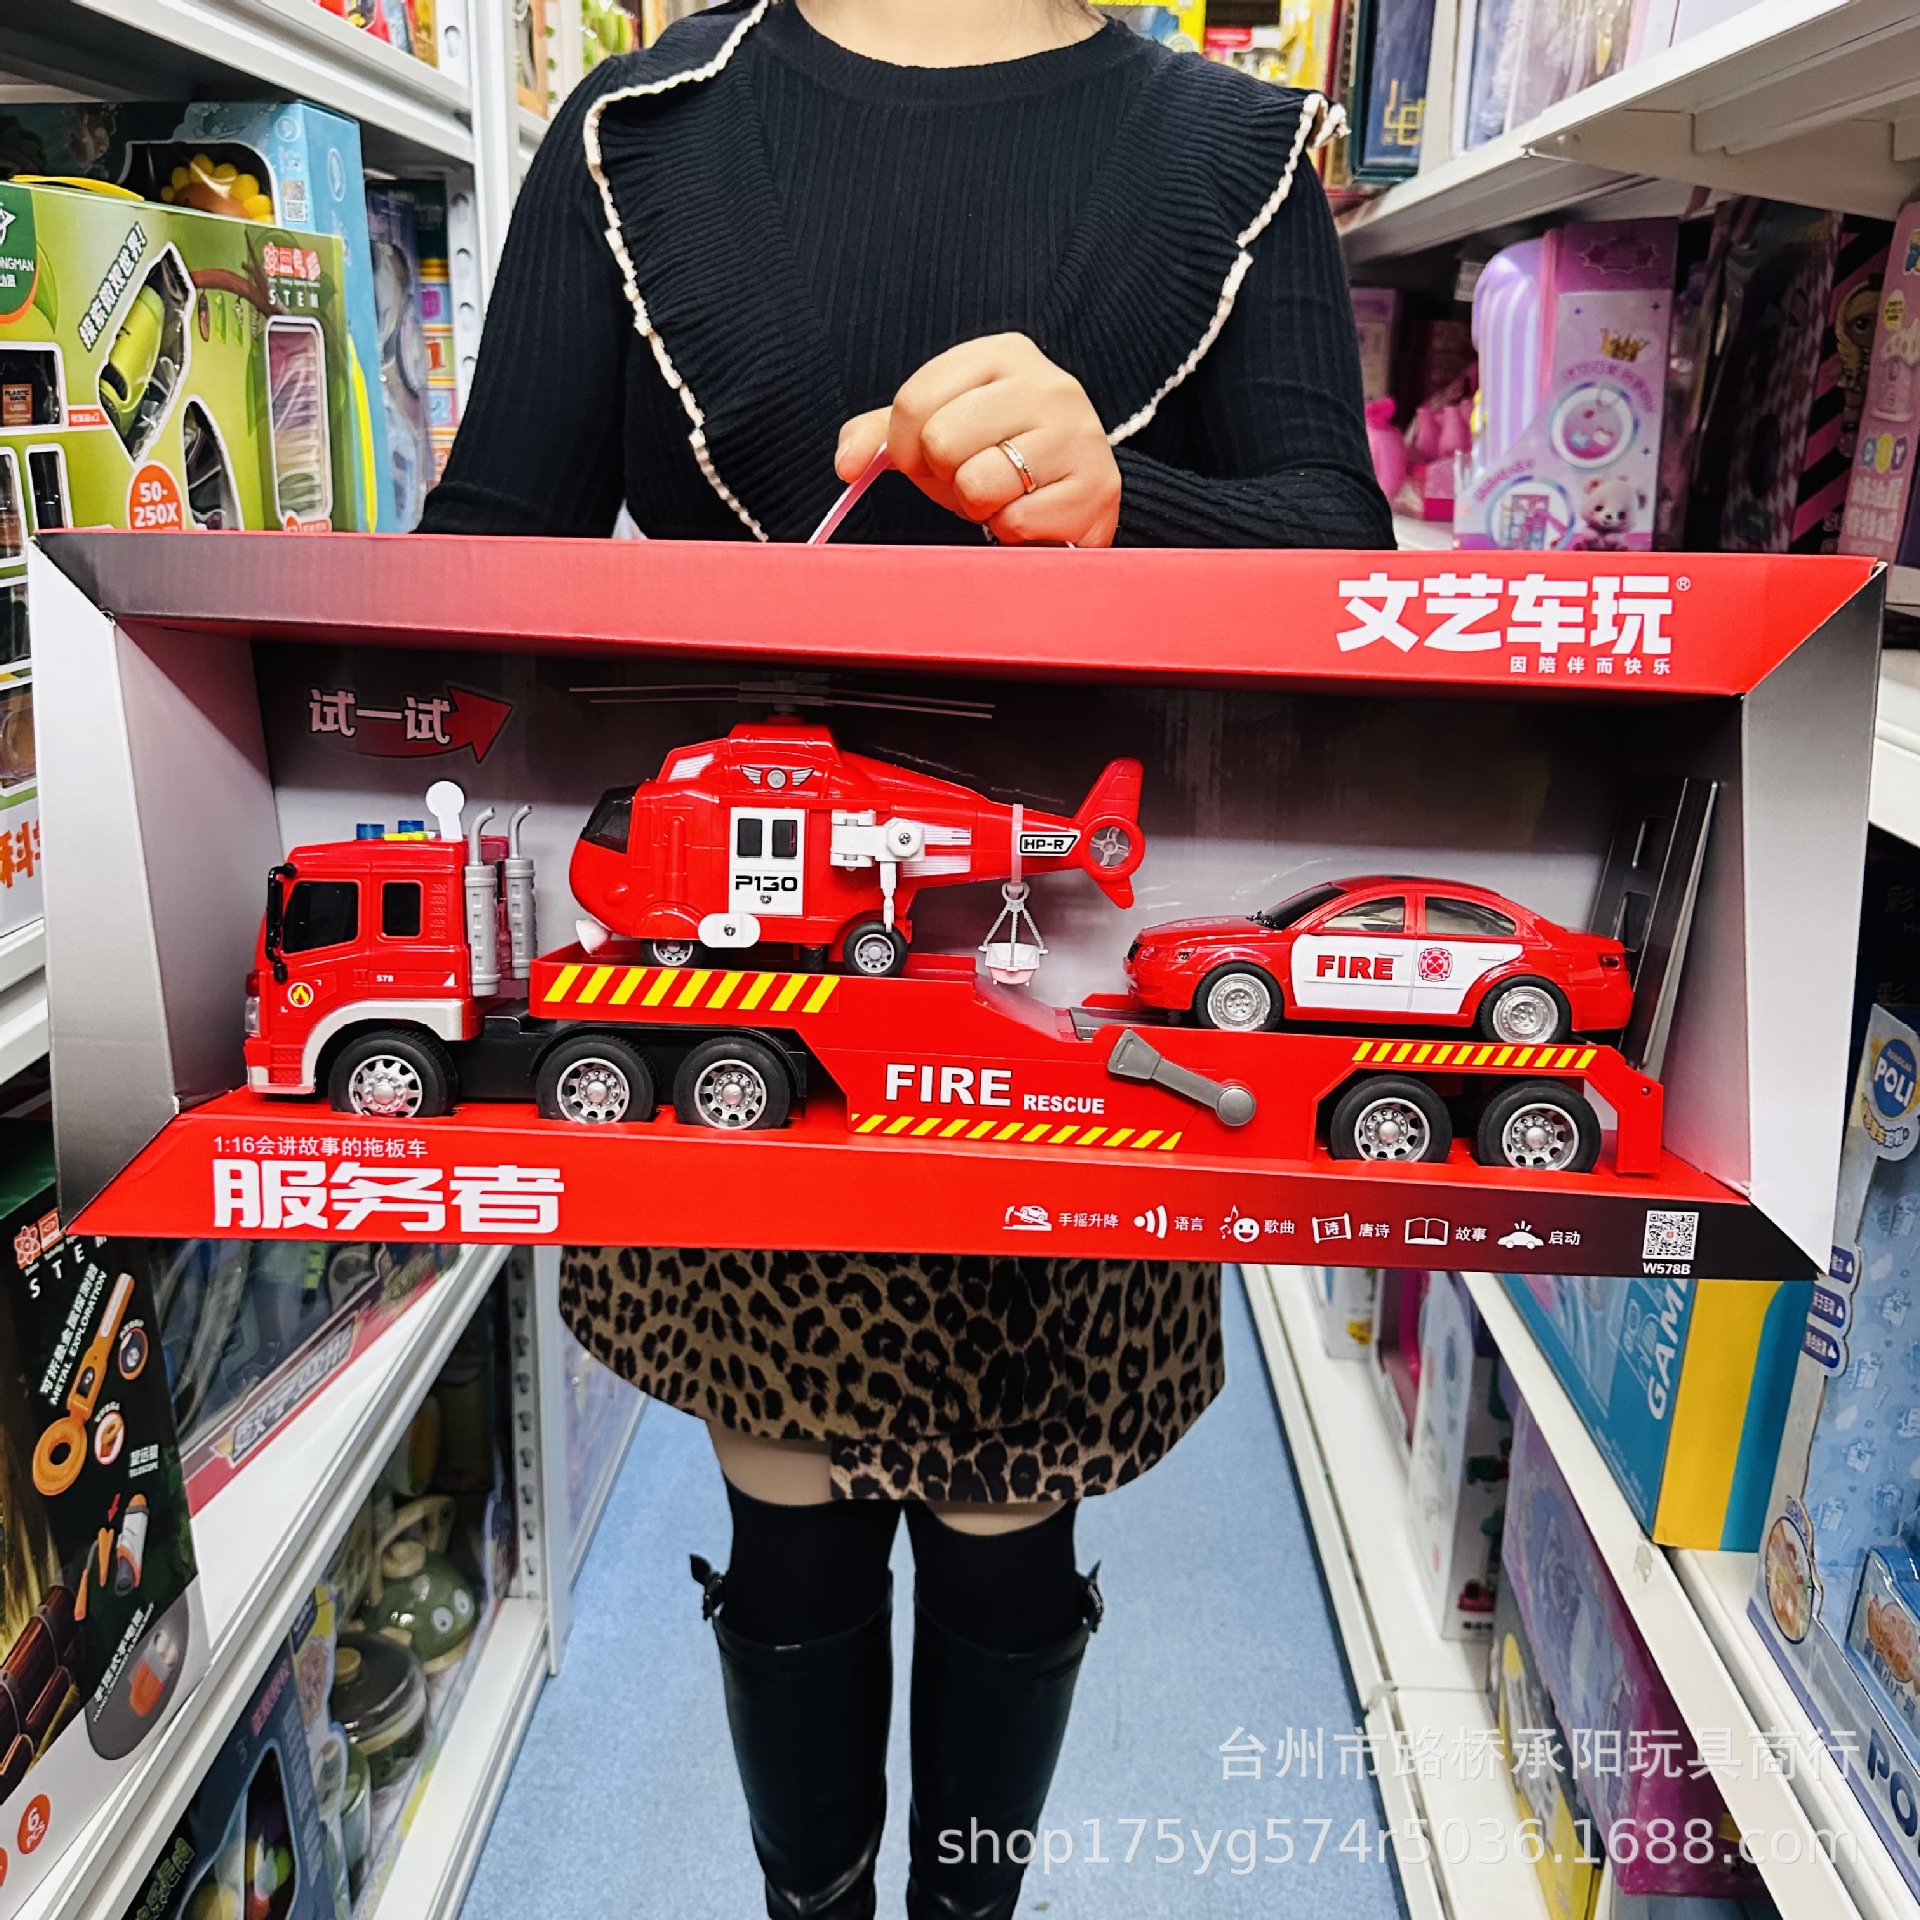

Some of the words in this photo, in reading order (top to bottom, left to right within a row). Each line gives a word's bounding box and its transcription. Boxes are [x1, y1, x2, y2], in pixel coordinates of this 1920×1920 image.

[0, 257, 34, 271] NGMAN
[139, 482, 167, 502] 50-
[134, 503, 178, 527] 250X
[1336, 572, 1673, 655] 文艺车玩
[1509, 656, 1672, 675] 因陪伴而快乐
[309, 688, 451, 744] 试一试
[1023, 838, 1065, 852] HP-R
[735, 874, 798, 892] P130
[1316, 954, 1394, 981] FIRE
[885, 1063, 1014, 1107] FIRE
[1023, 1094, 1105, 1115] RESCUE
[1874, 1056, 1915, 1108] POLI
[213, 1135, 429, 1159] 1:16会讲故事的拖板车
[213, 1158, 565, 1234] 服务者
[1058, 1212, 1119, 1229] 手摇升降
[1174, 1216, 1205, 1232] 语言
[1264, 1219, 1295, 1235] 歌曲
[1323, 1220, 1340, 1236] 诗
[1358, 1223, 1391, 1239] 唐诗
[1455, 1226, 1487, 1243] 故事
[1548, 1230, 1581, 1246] 启动
[1642, 1262, 1691, 1275] W578B
[50, 1360, 73, 1406] METAL
[68, 1270, 108, 1358] EXPLORATION
[1867, 1727, 1920, 1857] PO
[27, 1806, 40, 1832] 6
